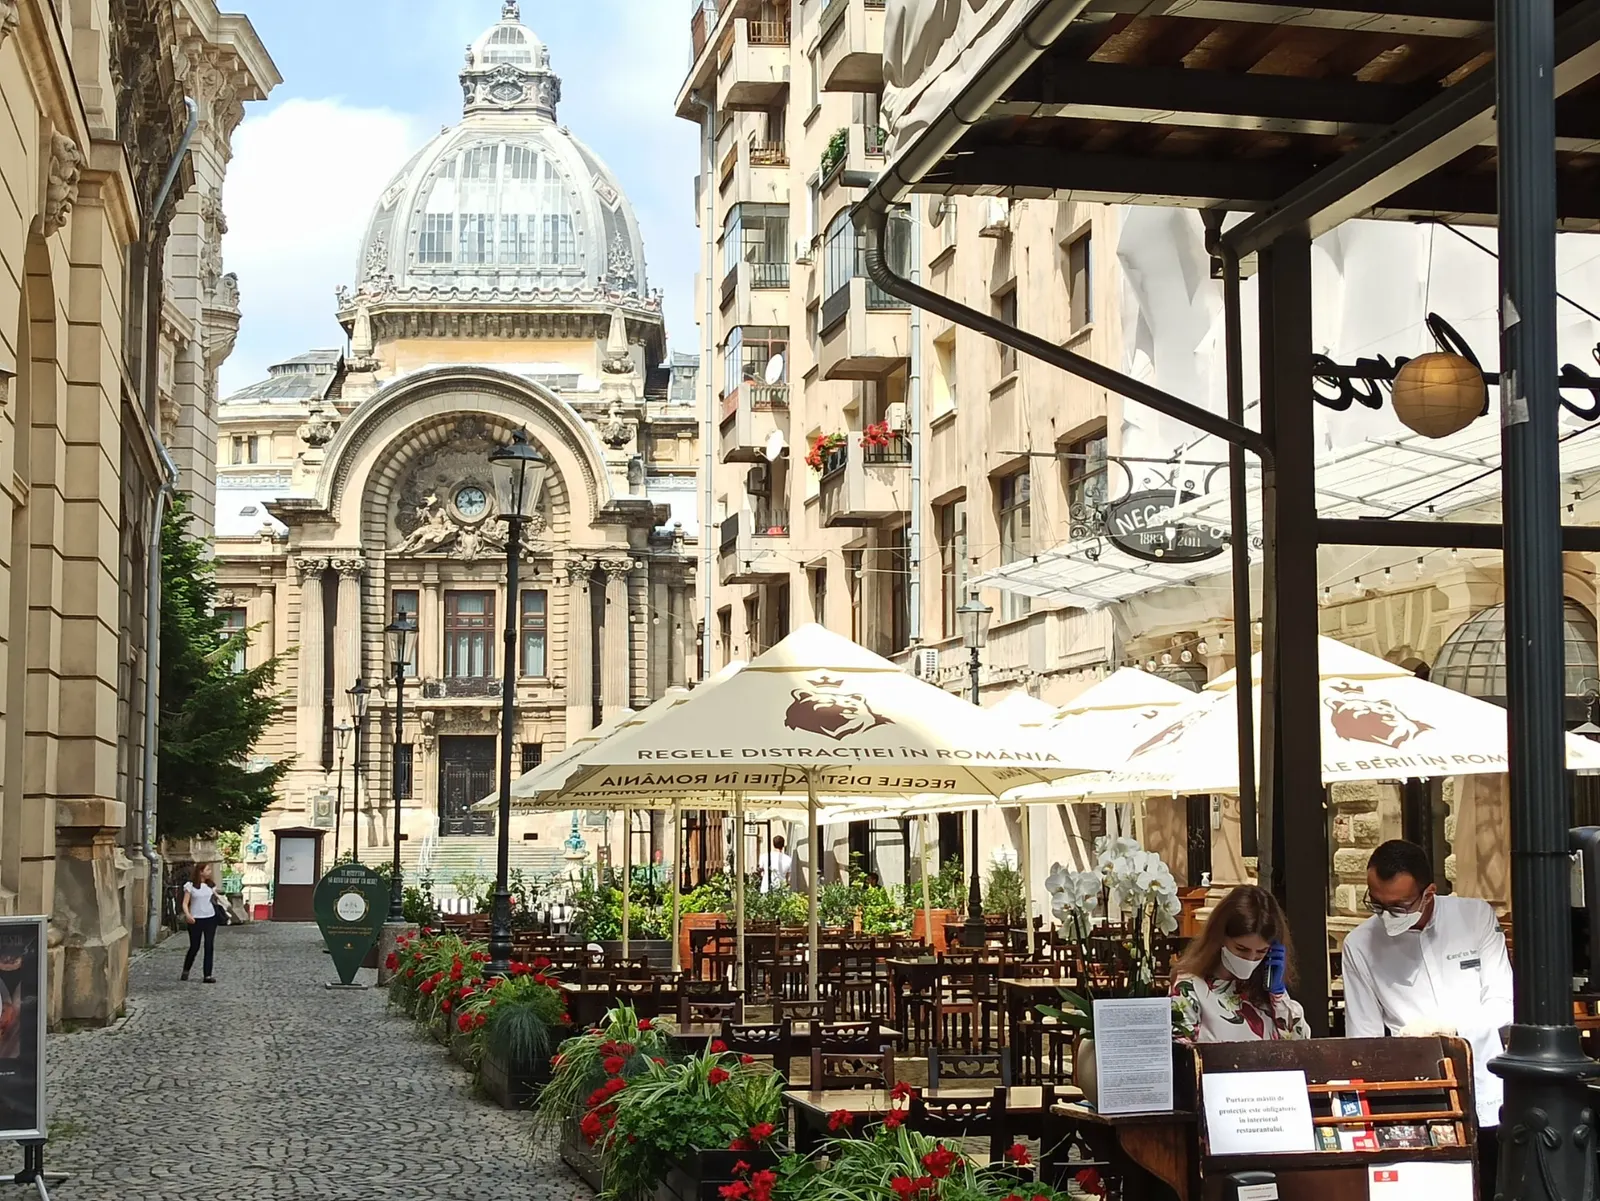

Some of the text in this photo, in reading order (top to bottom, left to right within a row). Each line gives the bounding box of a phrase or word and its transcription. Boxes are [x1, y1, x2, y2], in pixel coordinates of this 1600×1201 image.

[638, 748, 734, 760] REGELE
[901, 746, 929, 758] ÎN
[936, 748, 1062, 763] ROMÂNIA
[1451, 754, 1509, 765] ROM
